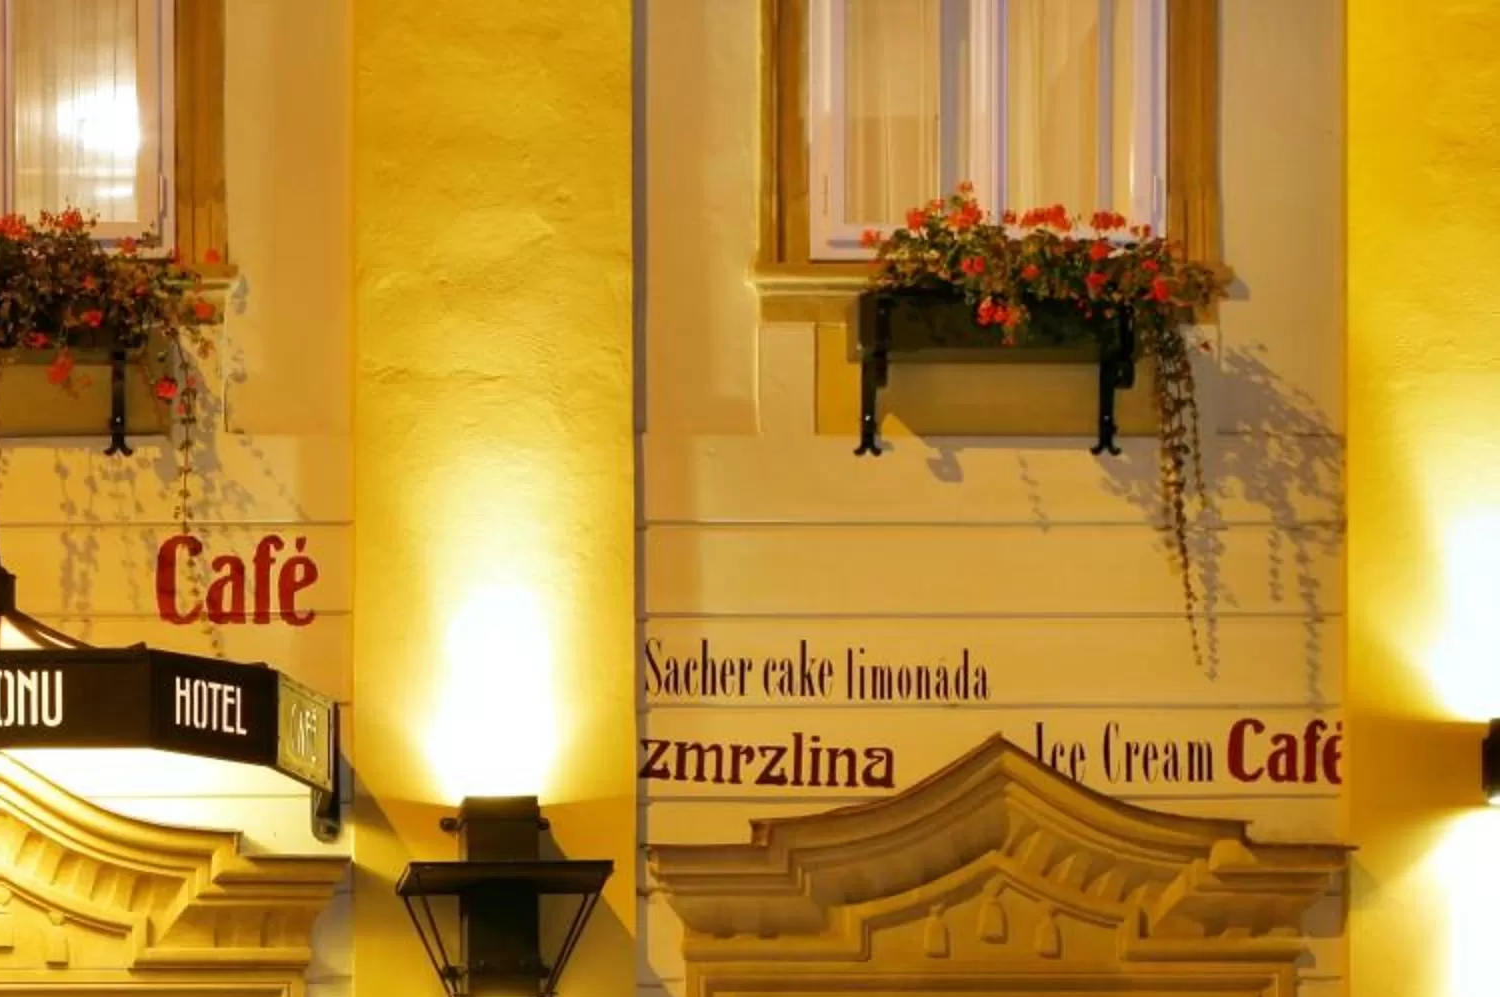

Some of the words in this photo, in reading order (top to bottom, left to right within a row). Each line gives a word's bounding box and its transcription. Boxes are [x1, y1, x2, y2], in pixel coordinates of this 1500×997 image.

[155, 534, 319, 627] Café
[645, 638, 753, 698] Sacher
[763, 639, 835, 698] cake
[174, 675, 248, 736] HOTEL
[638, 731, 896, 789] zmrzlina
[1034, 721, 1087, 784] Ice
[1102, 720, 1214, 785] Cream
